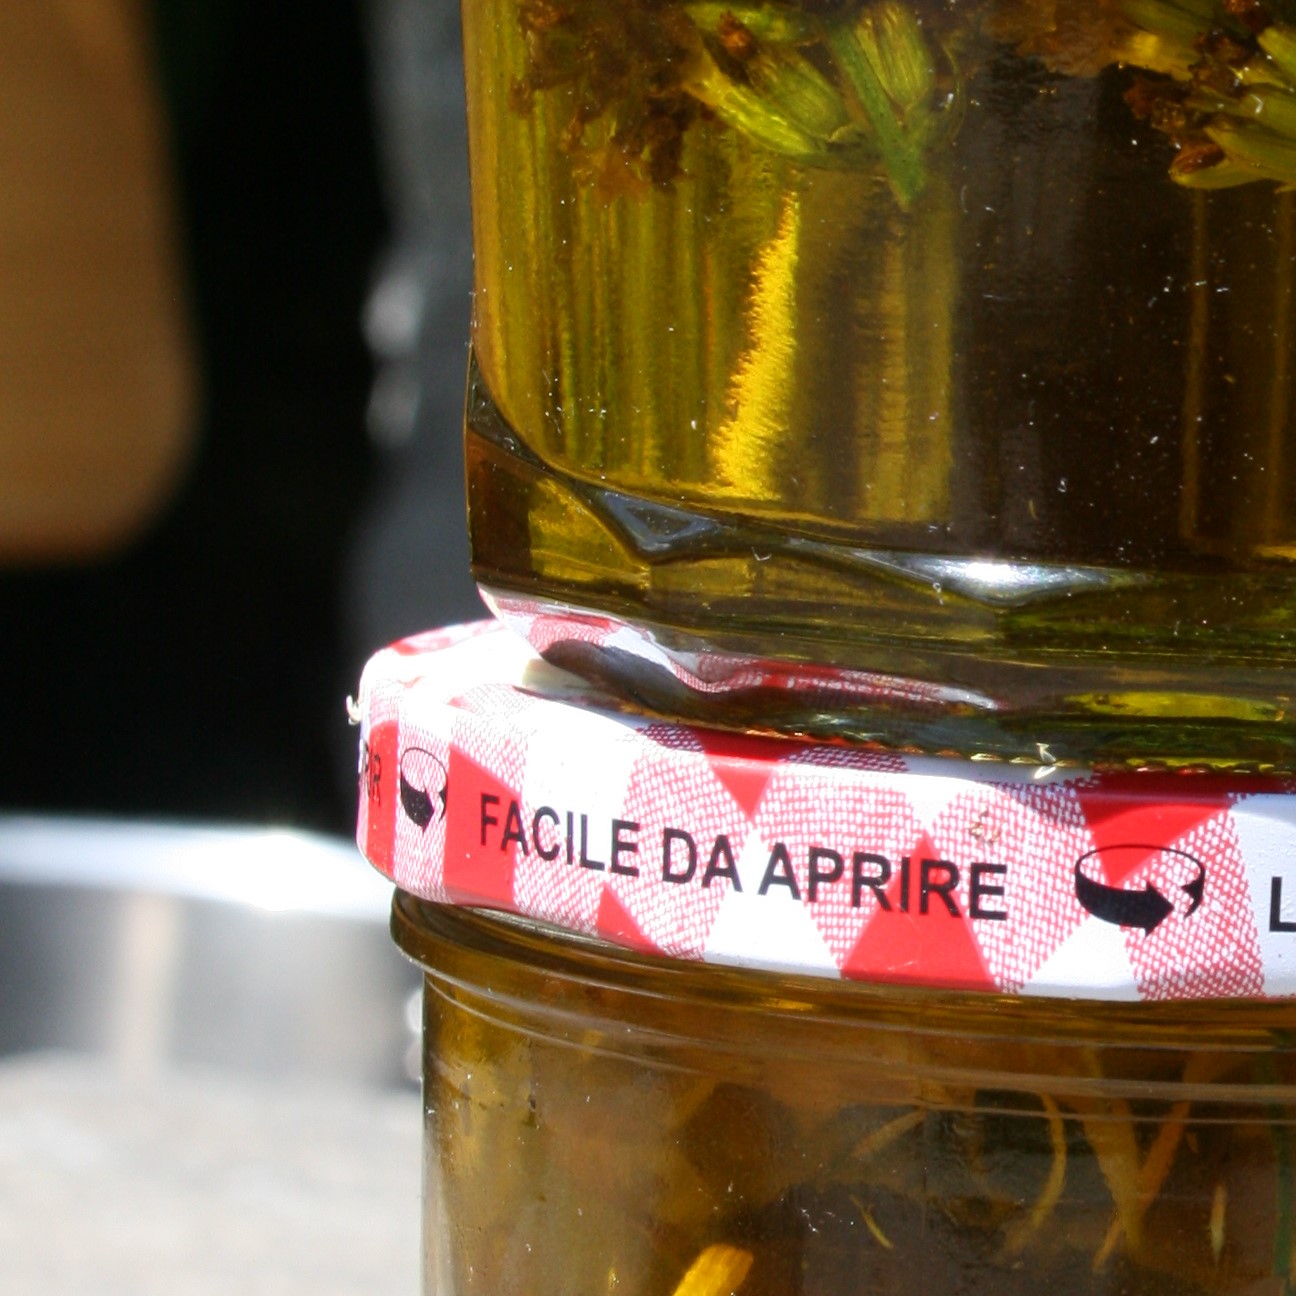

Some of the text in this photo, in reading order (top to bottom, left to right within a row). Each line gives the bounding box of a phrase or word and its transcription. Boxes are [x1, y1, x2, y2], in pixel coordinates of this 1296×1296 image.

[480, 793, 1009, 922] FACILE DA APRIRE
